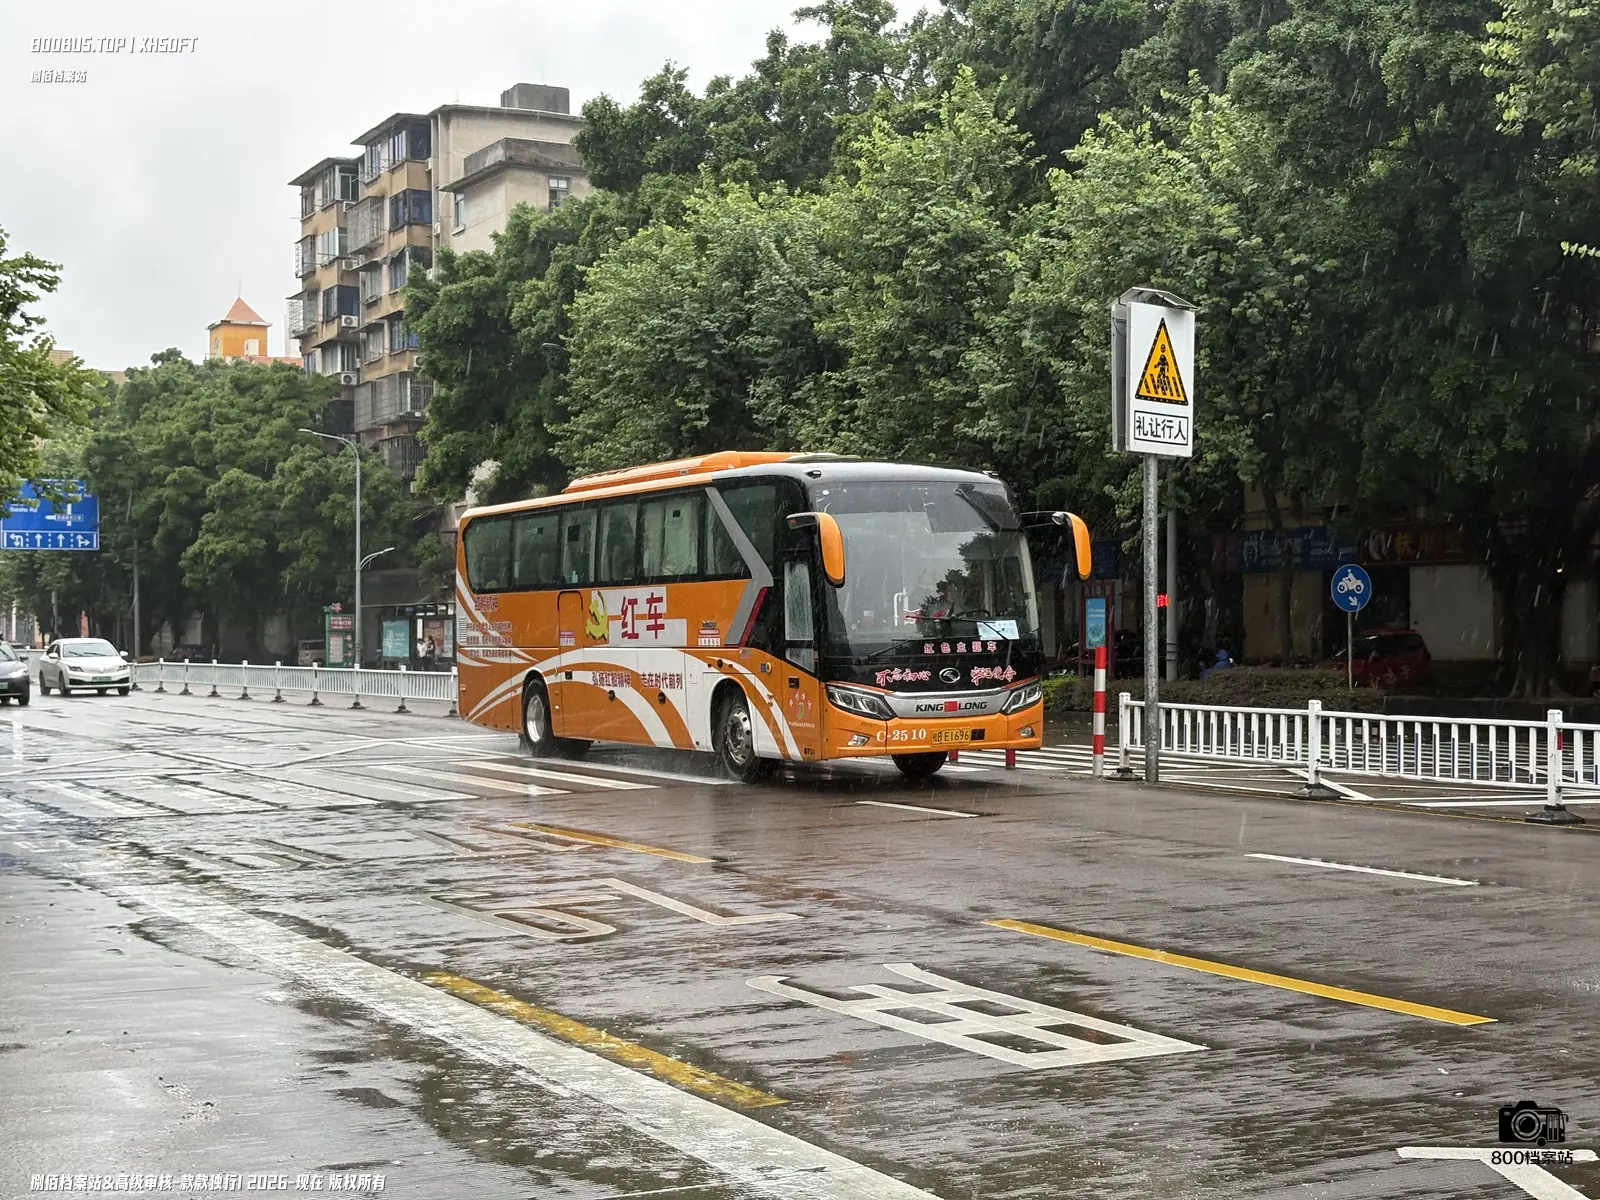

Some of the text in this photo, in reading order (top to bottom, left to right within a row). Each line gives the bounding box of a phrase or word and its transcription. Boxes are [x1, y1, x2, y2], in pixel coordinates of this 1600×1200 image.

[1136, 416, 1187, 441] 礼让行人
[620, 592, 666, 639] 红车
[640, 671, 683, 690] 走在时代前列
[915, 701, 988, 712] KING LONG
[744, 962, 1209, 1069] 用
